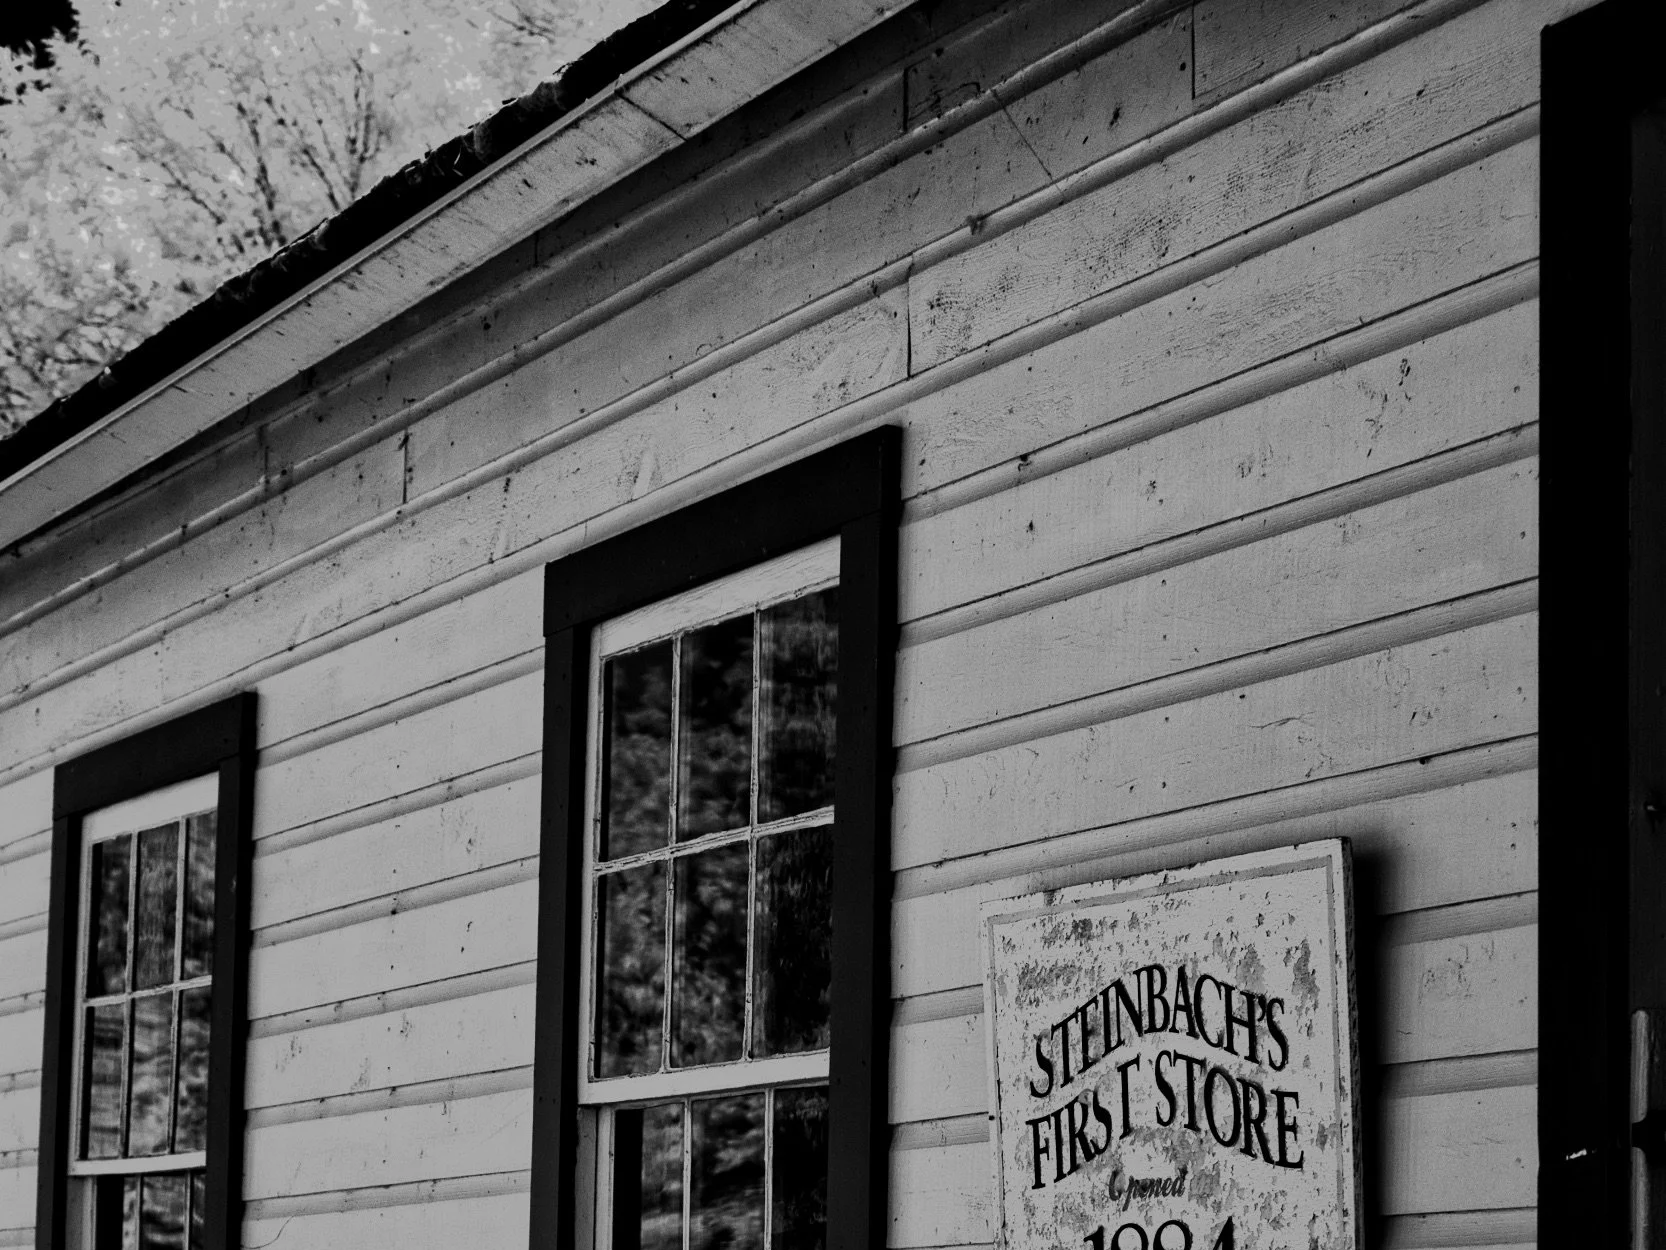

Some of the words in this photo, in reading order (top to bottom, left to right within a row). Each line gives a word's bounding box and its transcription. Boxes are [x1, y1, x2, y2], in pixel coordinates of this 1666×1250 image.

[1030, 964, 1289, 1098] STEINBACH'S
[1026, 1054, 1140, 1189] FIRST
[1155, 1050, 1304, 1169] STORE
